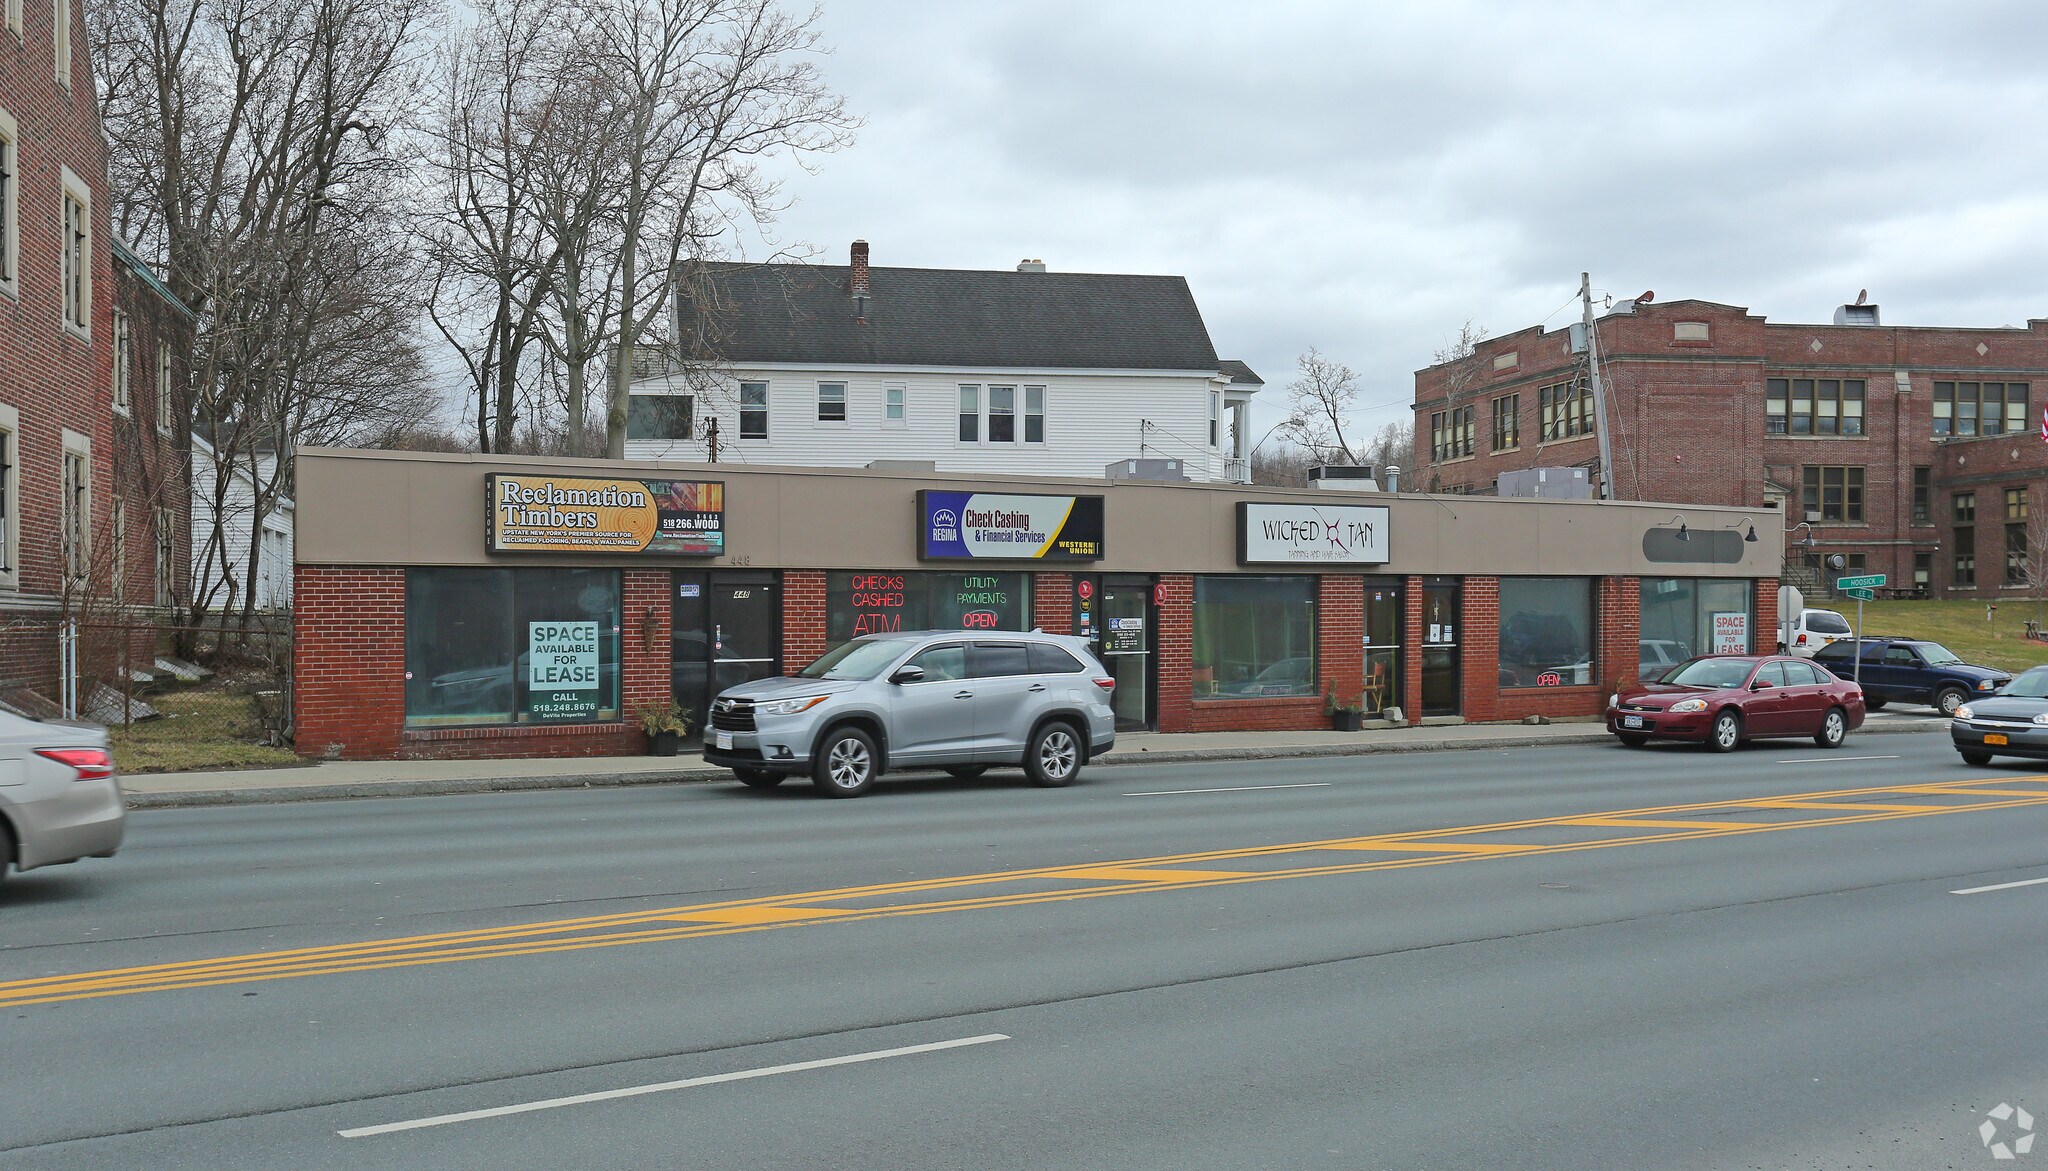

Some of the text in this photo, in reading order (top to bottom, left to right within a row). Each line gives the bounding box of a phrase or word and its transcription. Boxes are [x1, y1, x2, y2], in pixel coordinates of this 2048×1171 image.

[501, 481, 646, 507] Reclamation
[501, 504, 598, 528] Timbers
[966, 509, 1029, 531] Check Cashing
[663, 519, 719, 529] 518 266.WOOD
[933, 528, 957, 541] REGINA
[975, 530, 1046, 544] & Financial Services
[1263, 520, 1373, 548] WICKED TAN
[1058, 541, 1093, 549] WESTERN
[731, 556, 750, 566] 448
[852, 576, 904, 590] CHECKS
[964, 577, 999, 588] UTILITY
[1850, 578, 1876, 586] HOOSICK
[734, 590, 750, 598] 448
[852, 593, 904, 607] CASHED
[956, 592, 1006, 604] PAYMENTS
[1856, 590, 1866, 598] LEE
[853, 613, 901, 636] ATM
[963, 613, 997, 628] OPEN
[1716, 617, 1744, 628] SPACE
[534, 626, 594, 642] SPACE
[535, 645, 594, 654] AVAILABLE
[1716, 644, 1744, 654] LEASE
[554, 656, 576, 664] FOR
[534, 666, 595, 683] LEASE
[1537, 674, 1560, 686] OPEN
[552, 693, 578, 702] CALL
[534, 703, 595, 712] 518.248.8676
